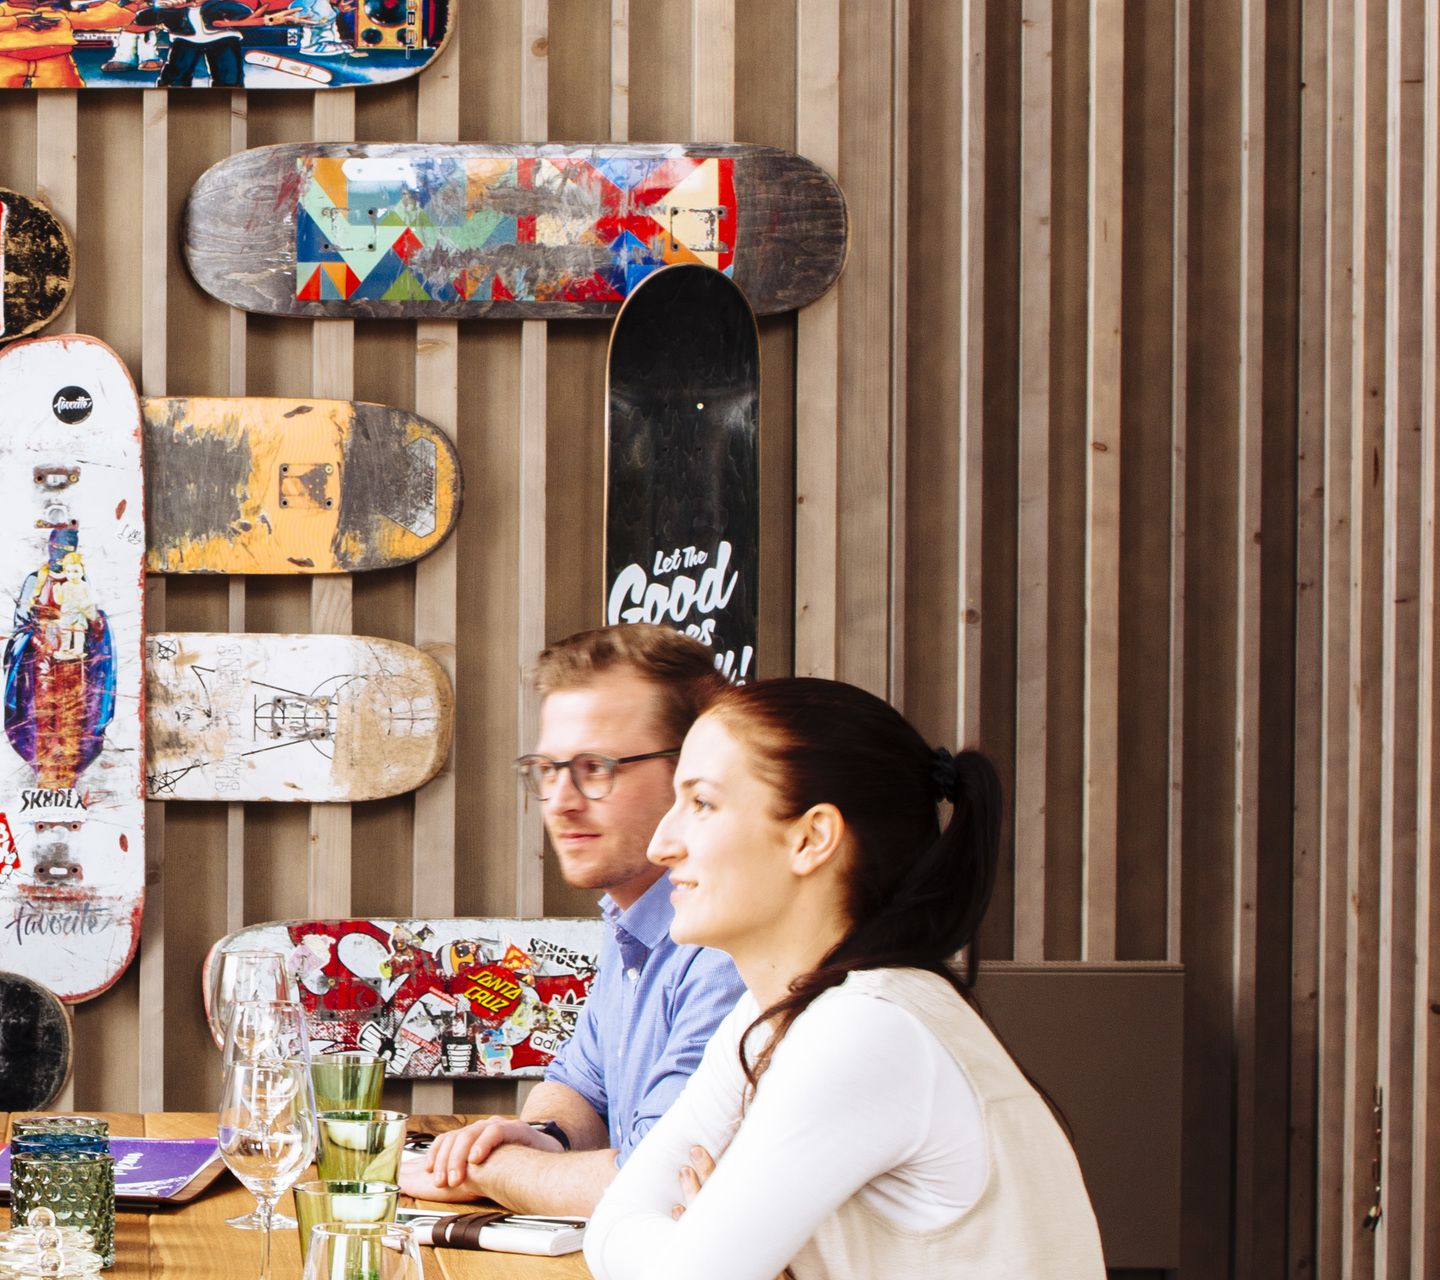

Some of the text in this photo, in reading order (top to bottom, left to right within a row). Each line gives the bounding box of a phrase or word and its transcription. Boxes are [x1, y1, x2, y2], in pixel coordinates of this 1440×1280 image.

[653, 546, 708, 576] Let The
[607, 541, 738, 626] Good
[464, 986, 510, 1013] CRUZ
[466, 971, 523, 1000] SANTA
